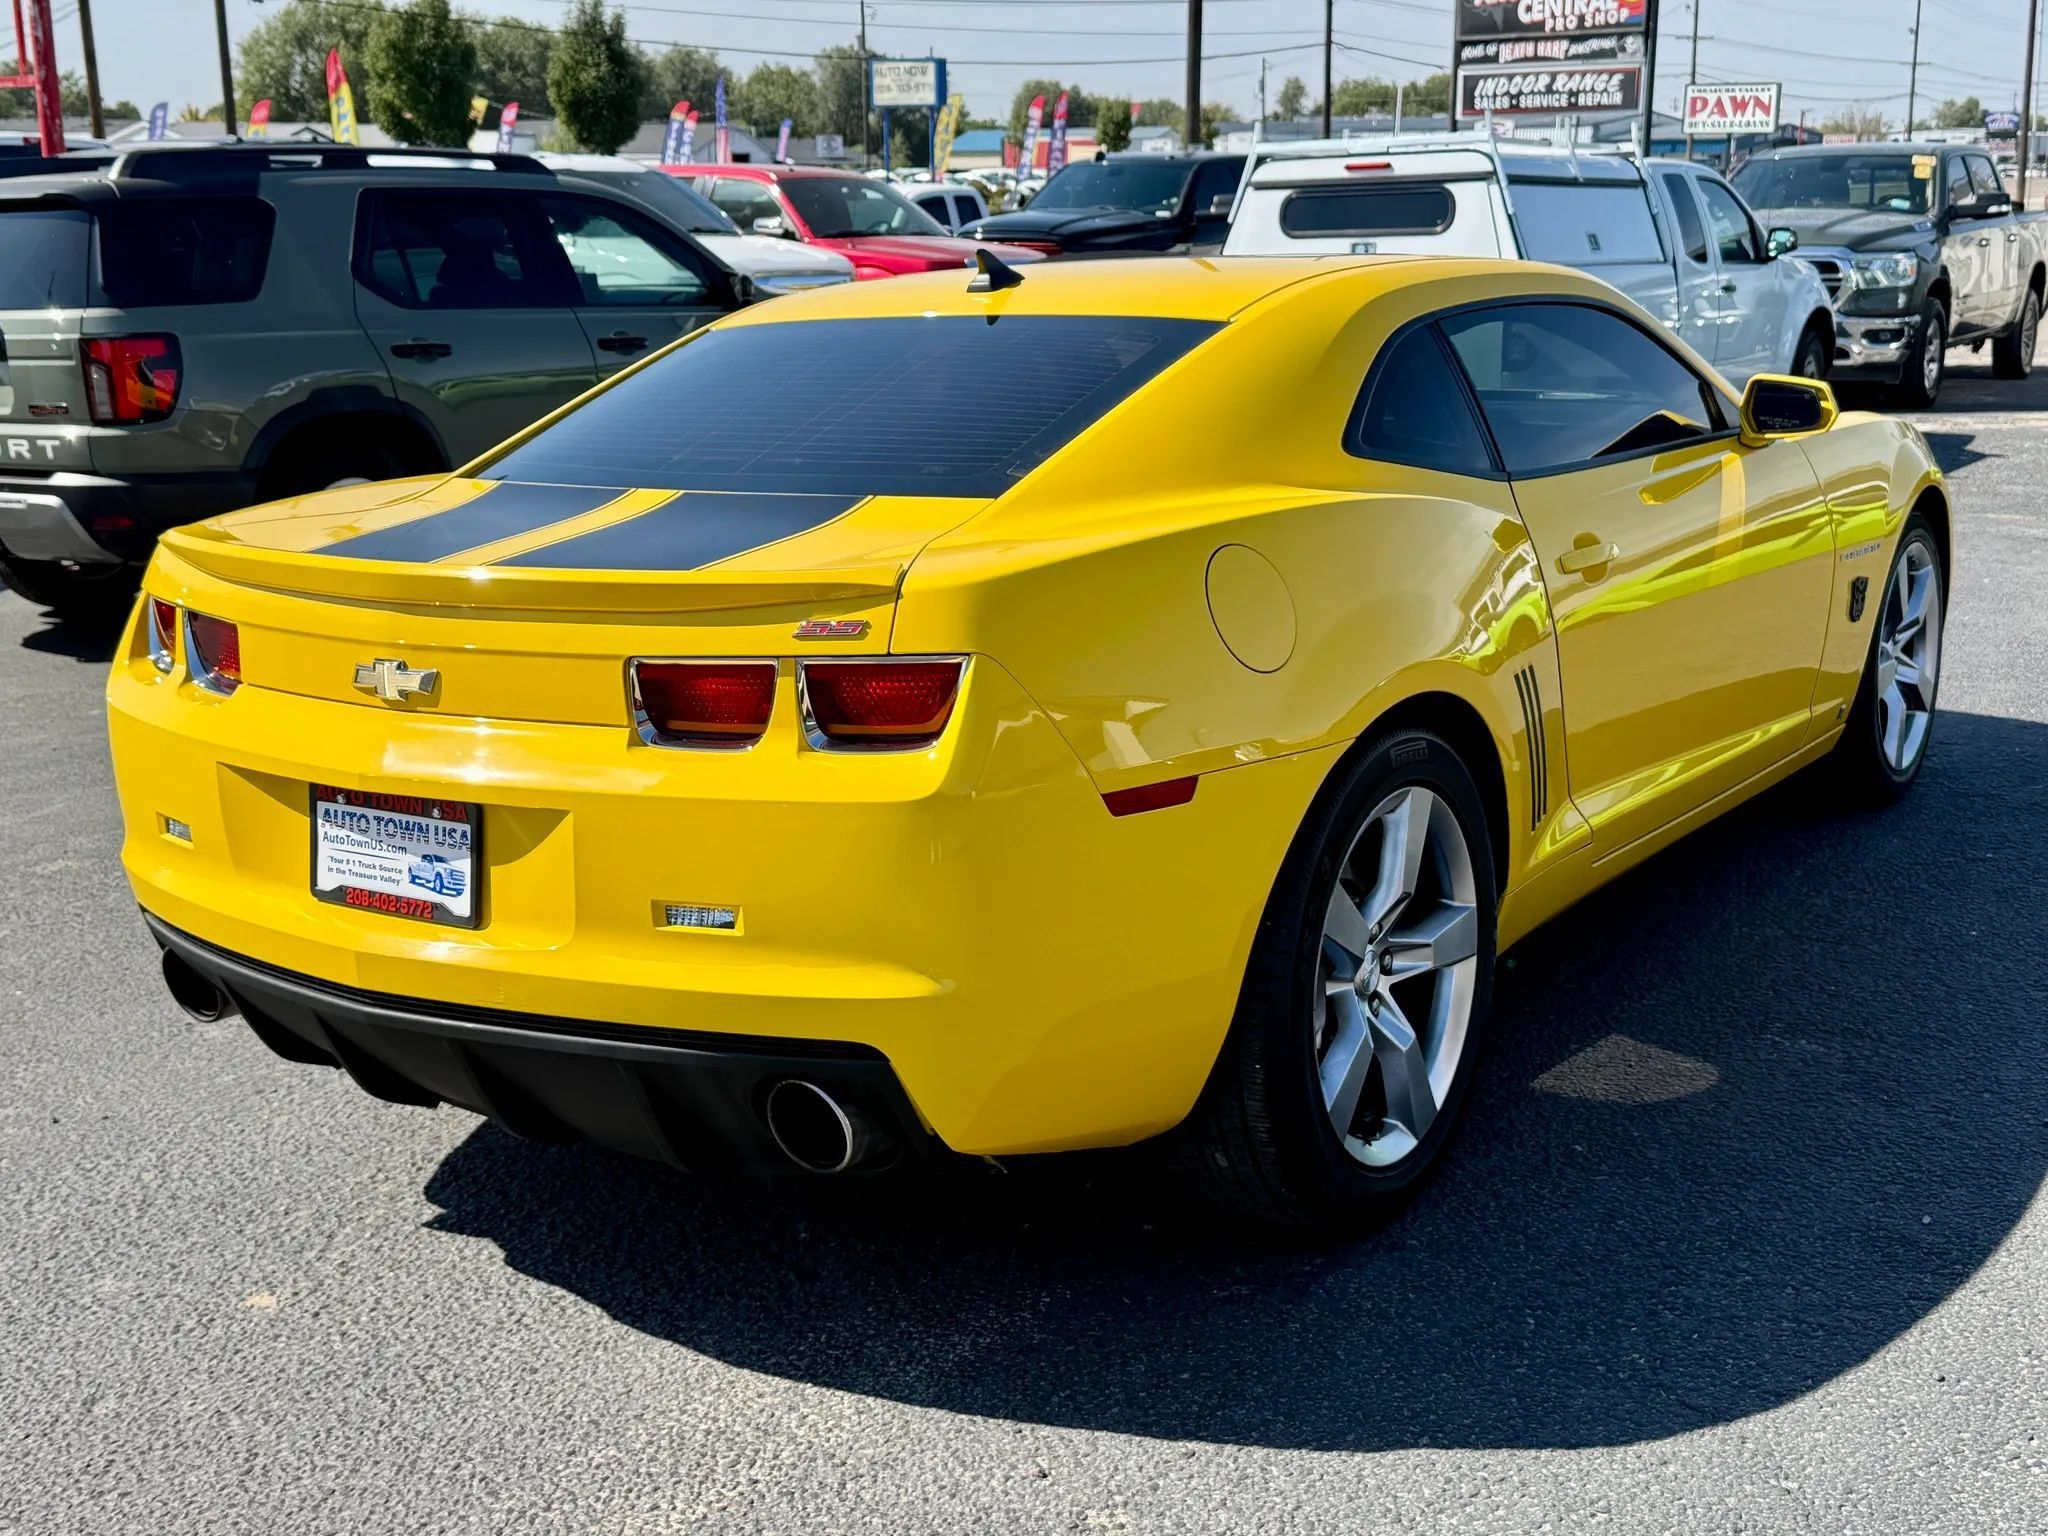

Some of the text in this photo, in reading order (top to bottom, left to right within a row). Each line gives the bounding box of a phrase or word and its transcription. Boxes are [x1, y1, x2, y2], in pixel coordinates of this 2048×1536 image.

[1545, 7, 1630, 33] PRO SHOP
[1461, 44, 1485, 62] HOME
[1486, 42, 1498, 56] OF
[1498, 41, 1535, 64] DEATH
[1474, 72, 1625, 98] INDOOR RANGE
[1474, 91, 1624, 110] SALES SERVICE REPAIR
[1689, 95, 1773, 118] PAWN
[0, 438, 61, 460] RT
[793, 620, 866, 637] SS
[370, 793, 425, 816] TOWN
[321, 808, 471, 852] AUTO TOWN USA
[322, 831, 408, 855] AutoTownUS.com
[327, 865, 334, 873] in
[335, 866, 347, 876] the
[347, 868, 378, 881] Treasure
[357, 860, 377, 871] Truck
[378, 863, 403, 875] Source
